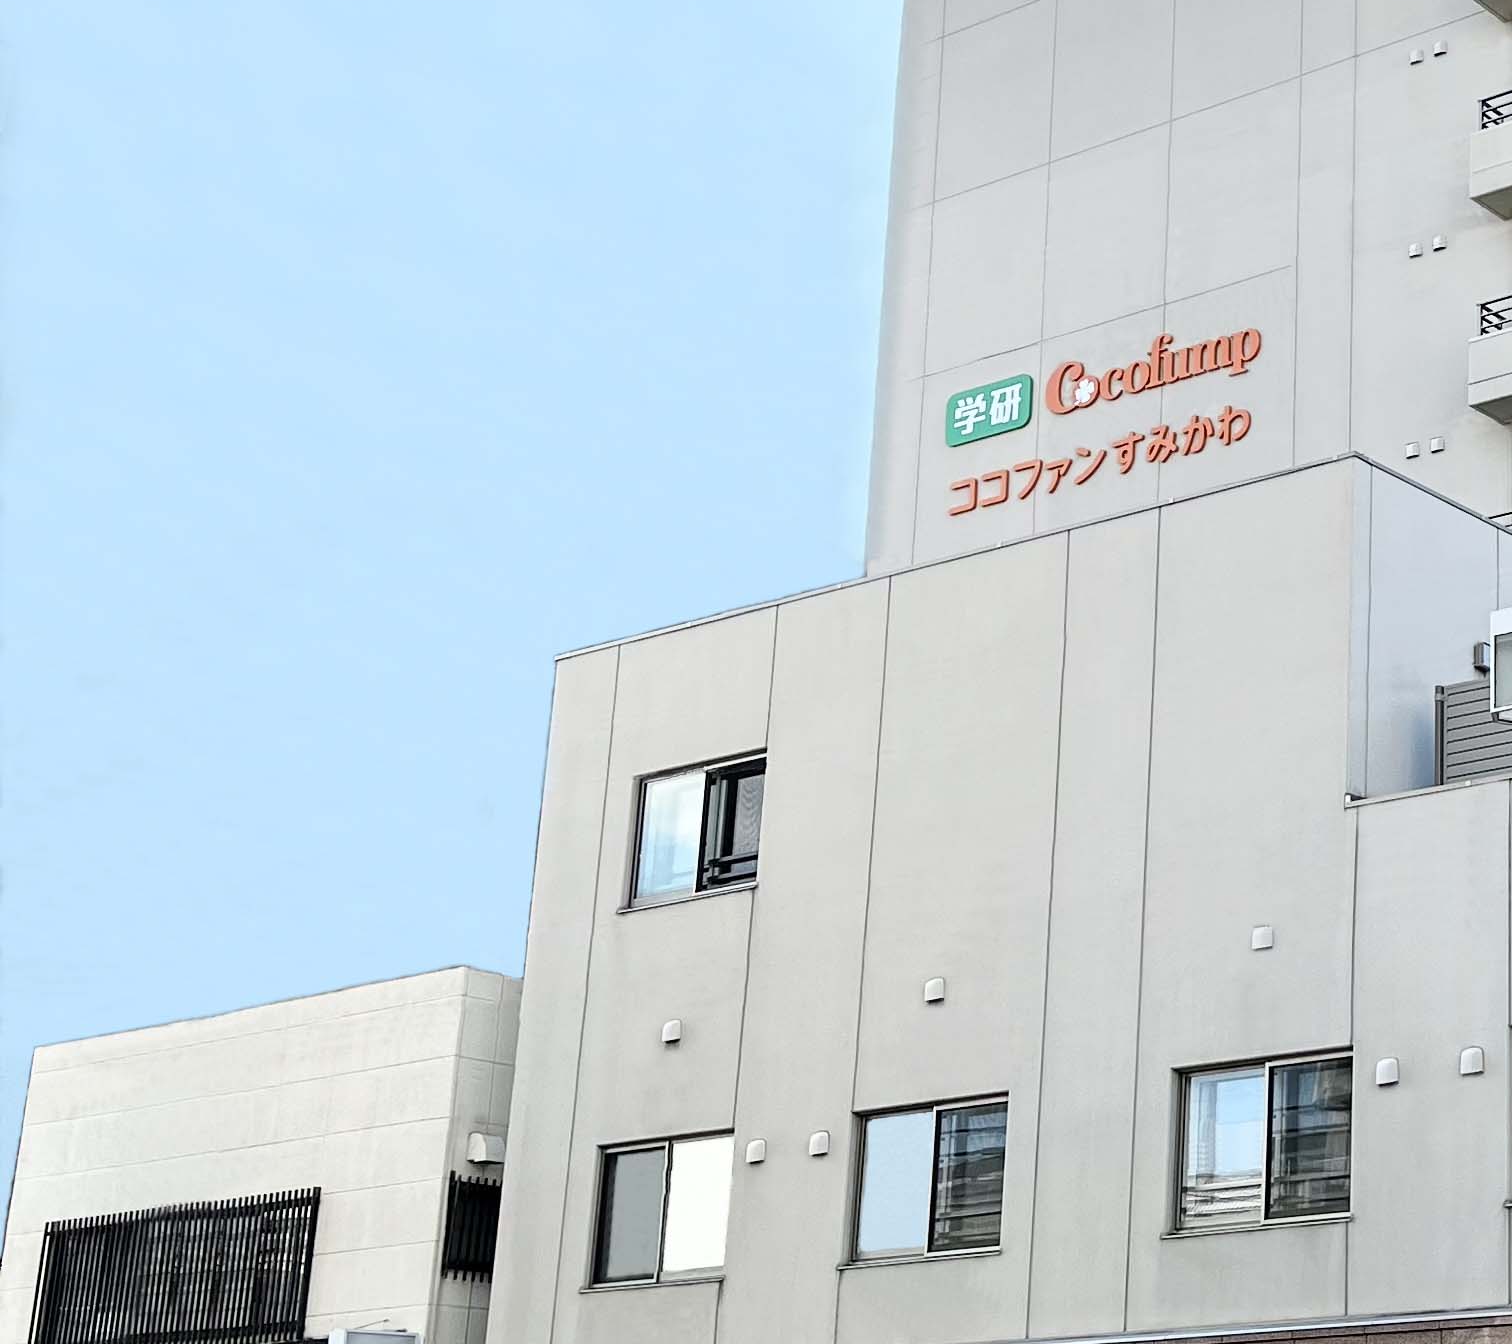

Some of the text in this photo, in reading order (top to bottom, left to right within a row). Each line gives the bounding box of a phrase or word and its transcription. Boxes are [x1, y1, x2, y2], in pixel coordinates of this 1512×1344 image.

[953, 326, 1262, 436] 学研 Cocofump
[948, 404, 1252, 517] ココファンすみかわ
